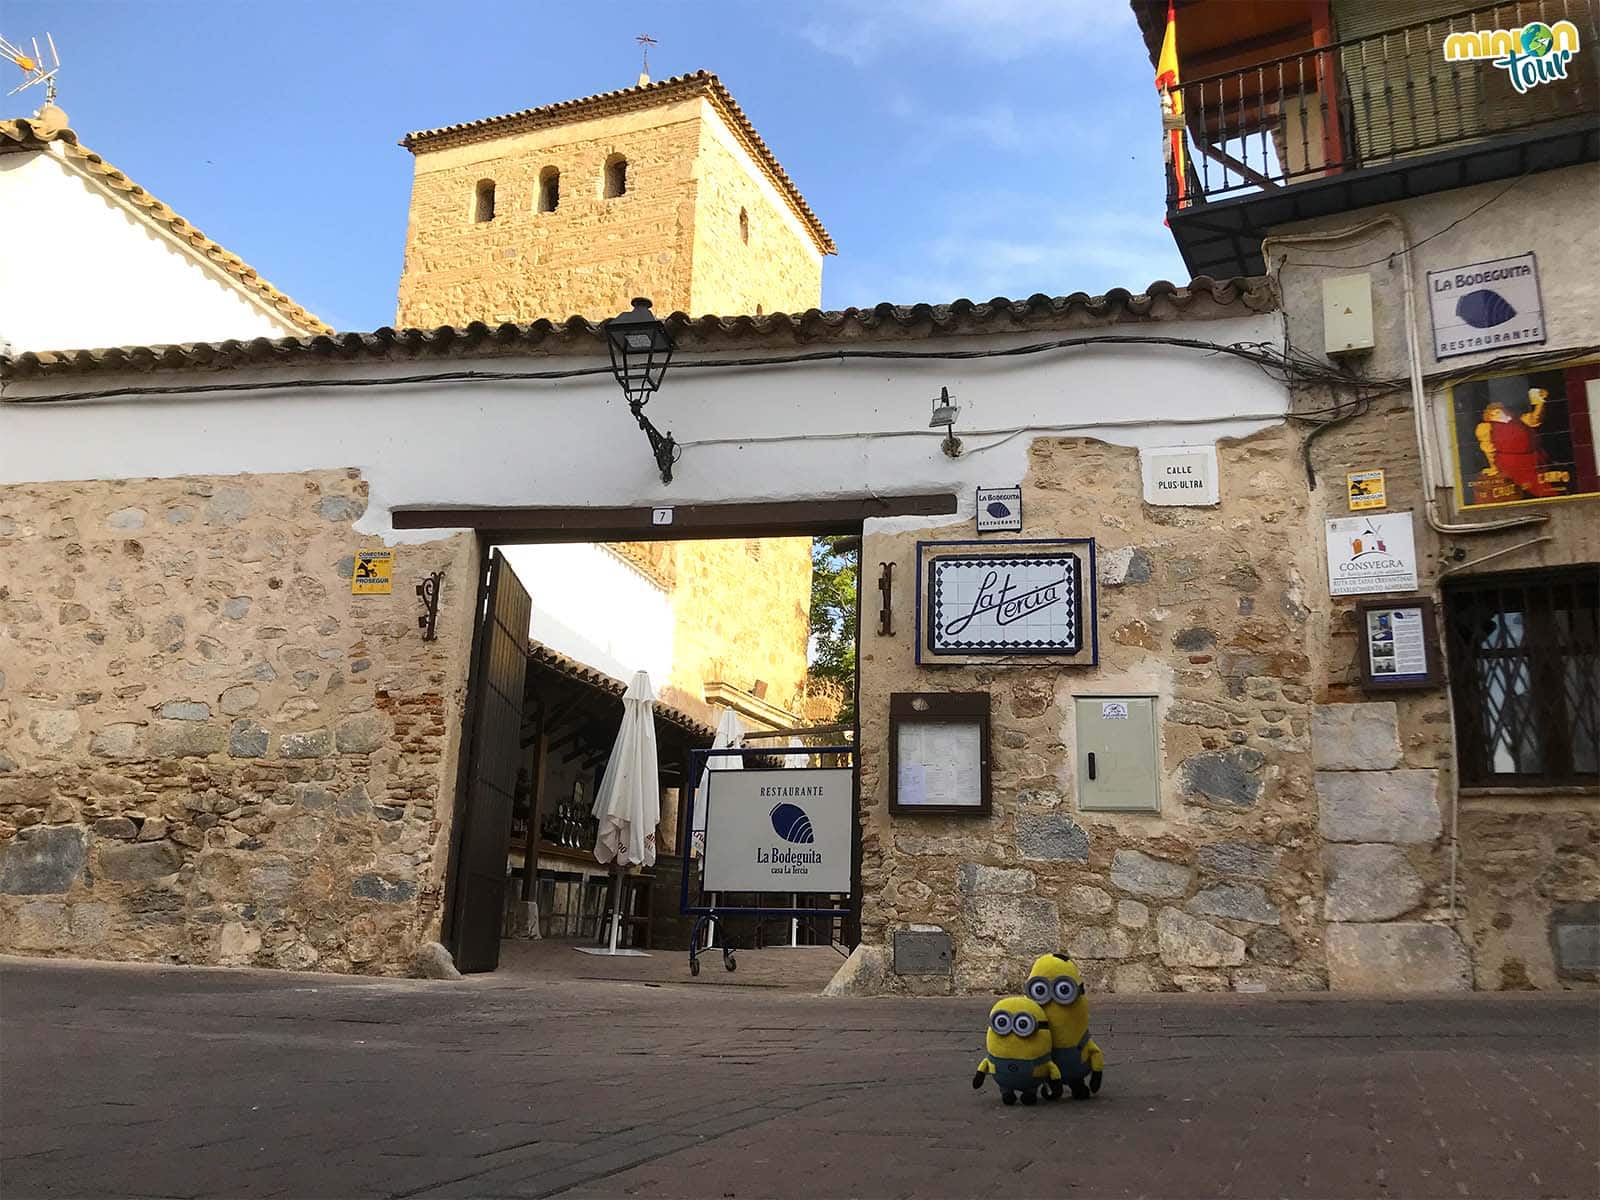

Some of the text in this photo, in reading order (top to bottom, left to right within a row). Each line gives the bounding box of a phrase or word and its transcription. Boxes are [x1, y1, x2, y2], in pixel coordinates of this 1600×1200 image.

[1434, 265, 1532, 293] LA BODEGUITA
[1440, 327, 1540, 352] RESTAURANTE
[1166, 466, 1193, 475] CALLE
[660, 511, 667, 522] 7
[1339, 559, 1405, 572] CONSVEGRA
[355, 577, 389, 585] PROSEGUR
[760, 786, 824, 797] RESTAURANTE
[757, 847, 822, 866] La Bodeguita
[784, 865, 791, 874] La
[792, 865, 808, 874] Tercia
